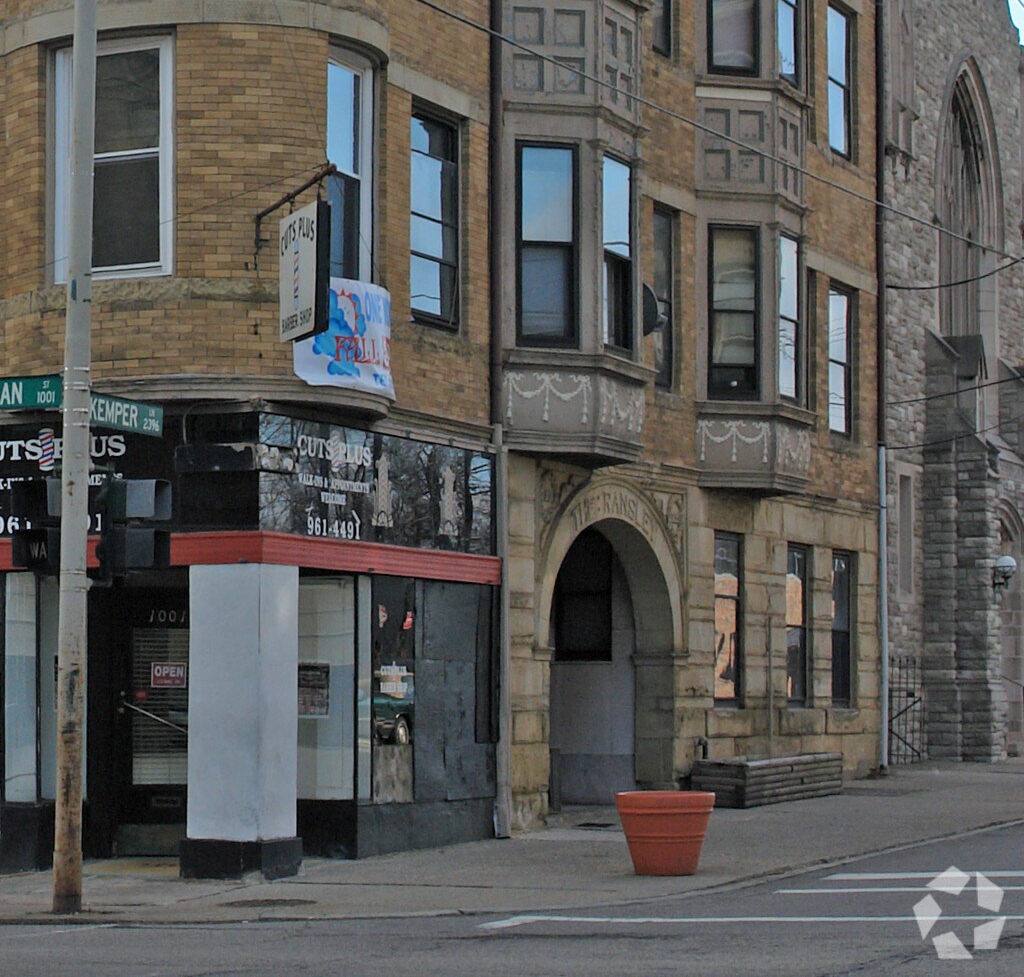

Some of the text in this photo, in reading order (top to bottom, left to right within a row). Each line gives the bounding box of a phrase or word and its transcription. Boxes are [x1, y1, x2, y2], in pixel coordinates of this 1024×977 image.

[280, 217, 315, 257] CUTS PLUS
[281, 307, 312, 334] BARBER SHOP
[37, 390, 55, 404] 1001
[42, 380, 50, 389] ST
[90, 397, 138, 427] KEMPER
[53, 434, 127, 459] PUS
[297, 435, 372, 466] CUTS PLUS
[149, 609, 186, 623] 1001
[154, 665, 184, 678] OPEN
